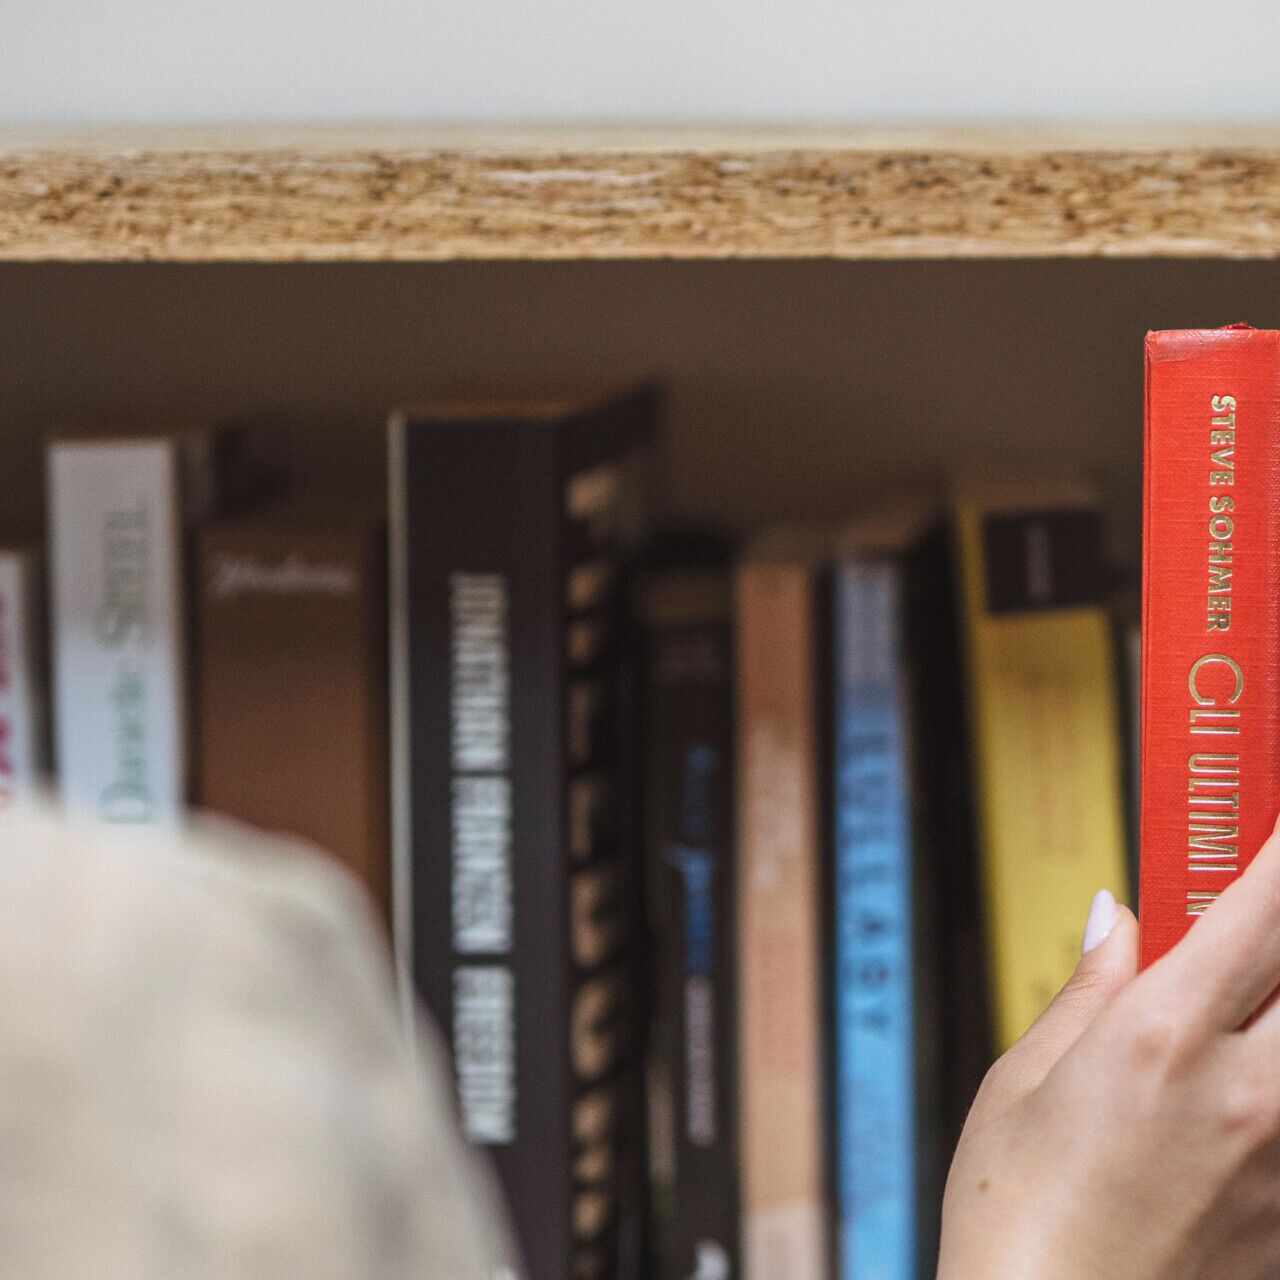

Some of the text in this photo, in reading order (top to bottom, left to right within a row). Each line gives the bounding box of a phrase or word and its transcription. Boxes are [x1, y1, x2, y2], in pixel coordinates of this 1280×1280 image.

[1206, 393, 1238, 633] STEVE SOHMER
[1187, 652, 1245, 735] GLI
[1186, 753, 1240, 872] ULTIMI
